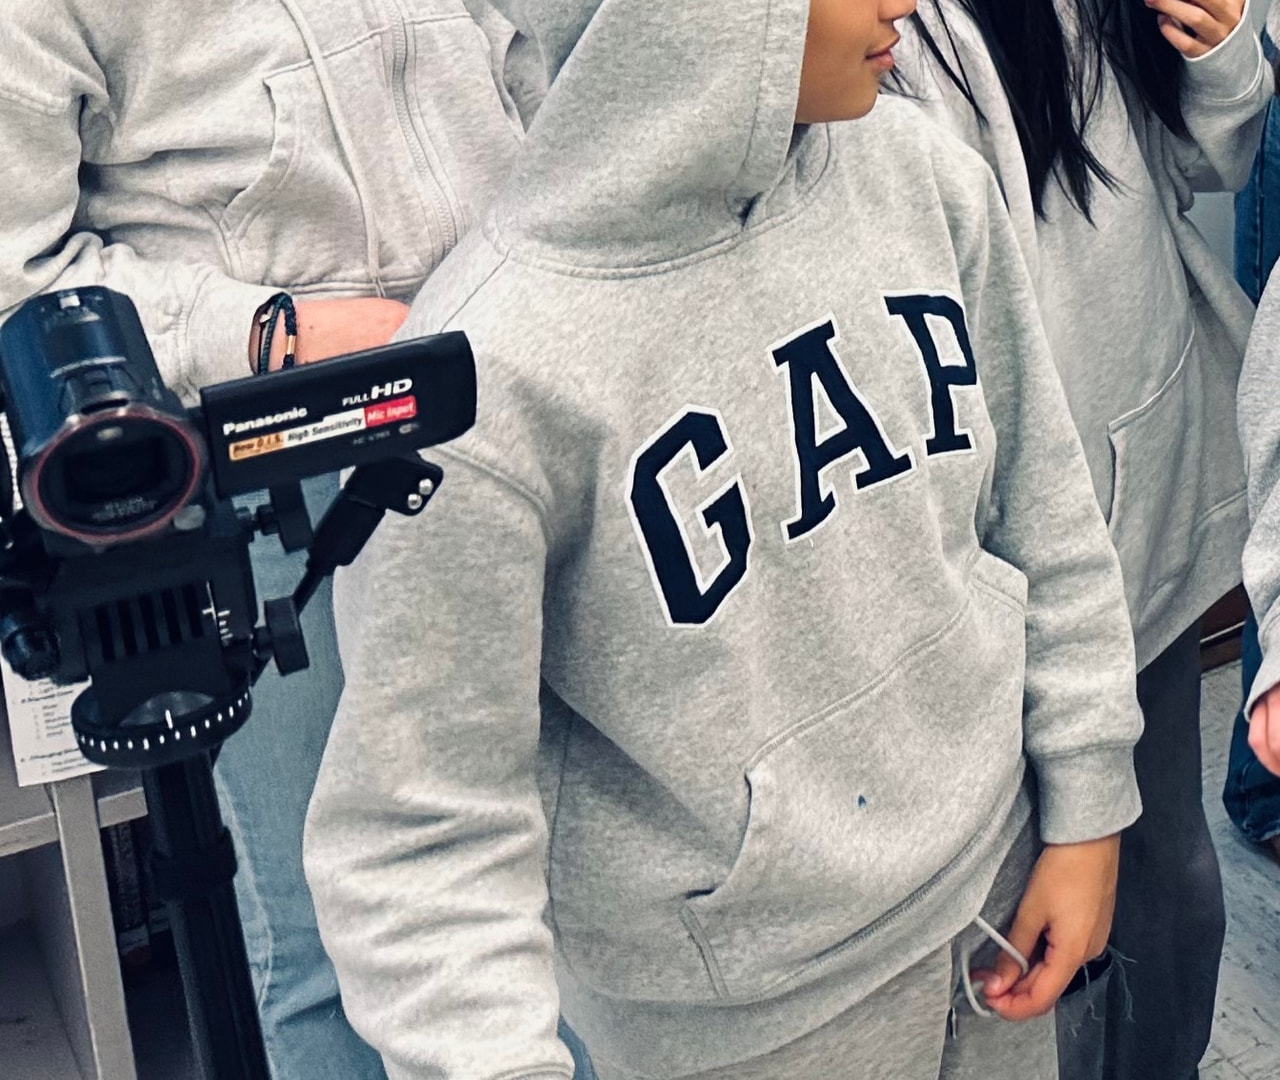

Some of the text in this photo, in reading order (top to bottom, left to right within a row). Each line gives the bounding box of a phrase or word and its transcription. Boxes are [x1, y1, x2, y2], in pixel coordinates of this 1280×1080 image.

[342, 378, 413, 408] FULL HD
[223, 407, 308, 436] Panasonic
[312, 417, 363, 437] Sensitivity
[367, 408, 386, 423] Mic
[387, 400, 416, 419] Input
[625, 289, 983, 628] GAP
